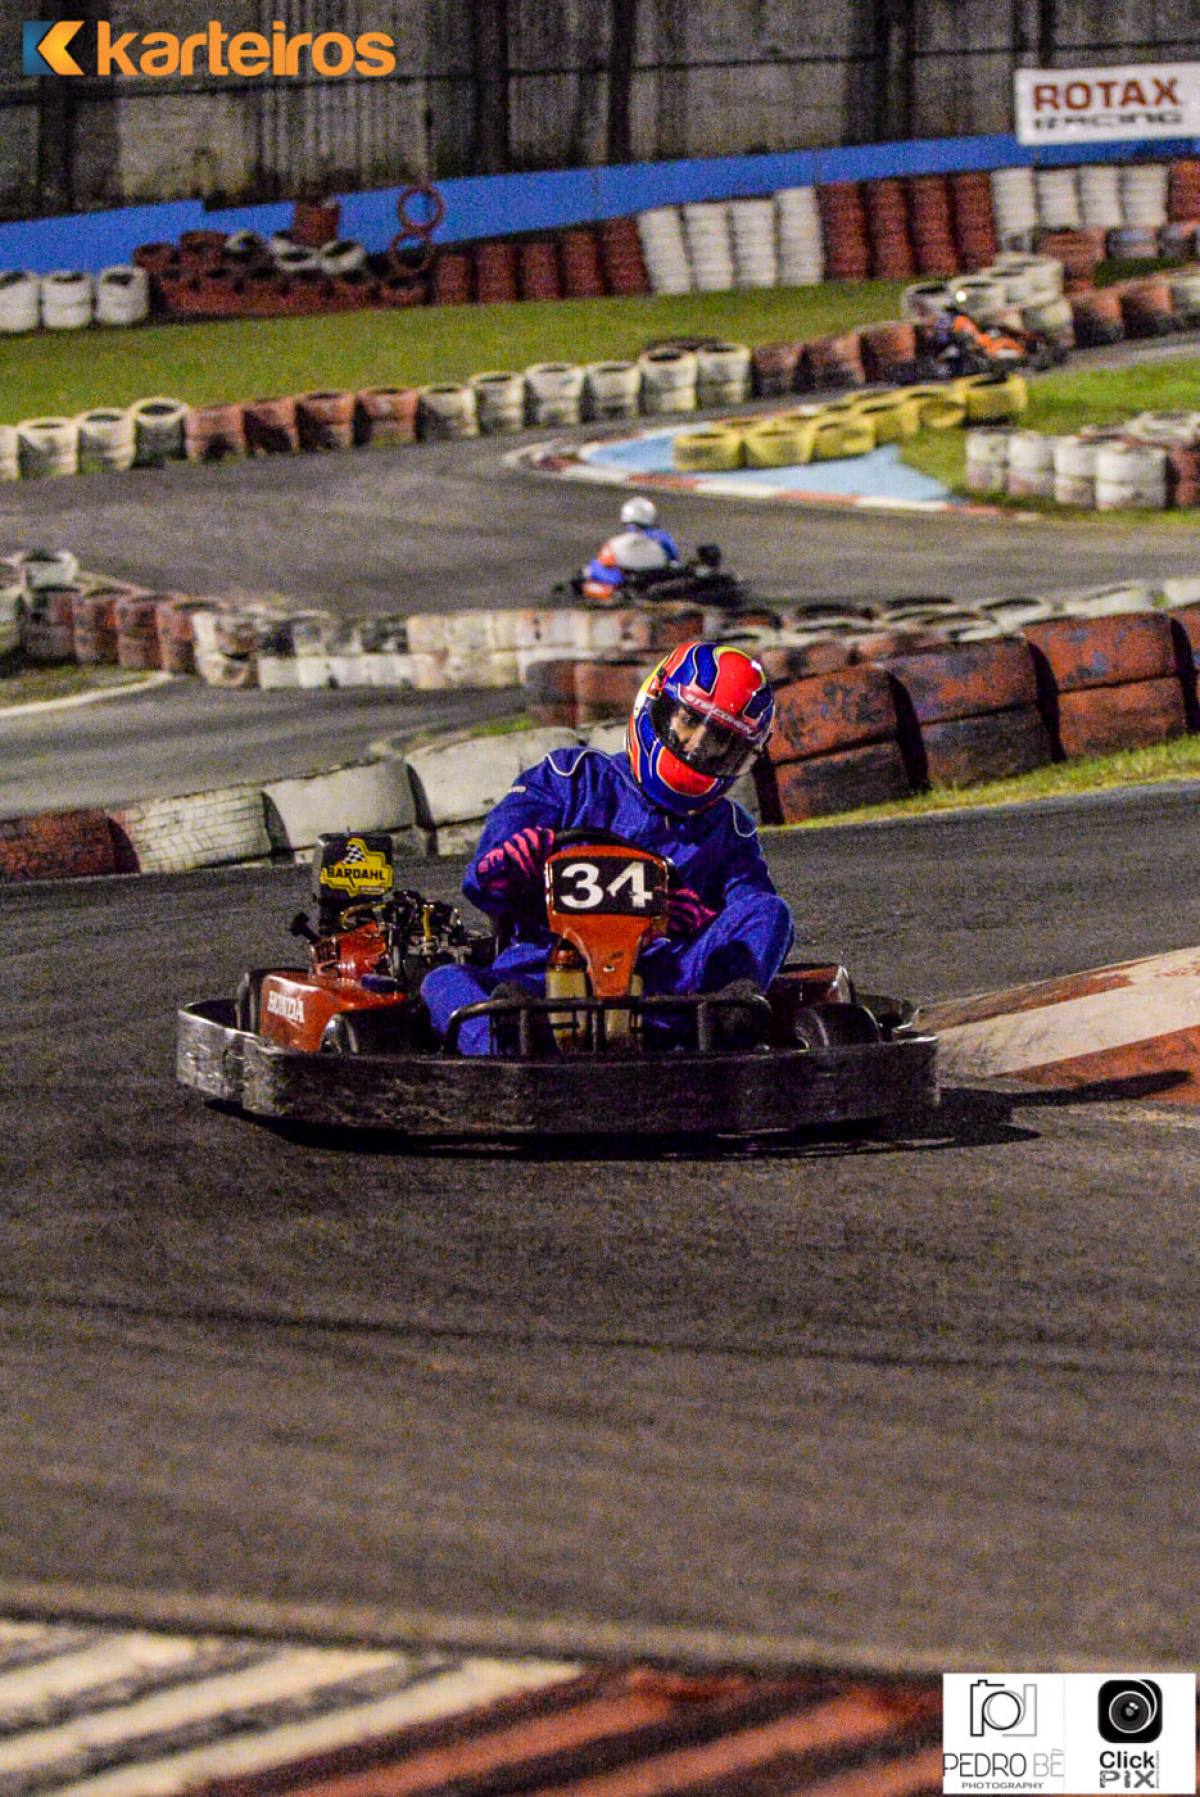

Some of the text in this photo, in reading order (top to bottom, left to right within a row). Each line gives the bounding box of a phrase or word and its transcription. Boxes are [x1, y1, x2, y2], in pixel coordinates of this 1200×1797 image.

[1033, 78, 1180, 111] ROTAX
[326, 866, 385, 880] BARDAHL
[560, 861, 653, 909] 34
[267, 990, 305, 1024] HONDA
